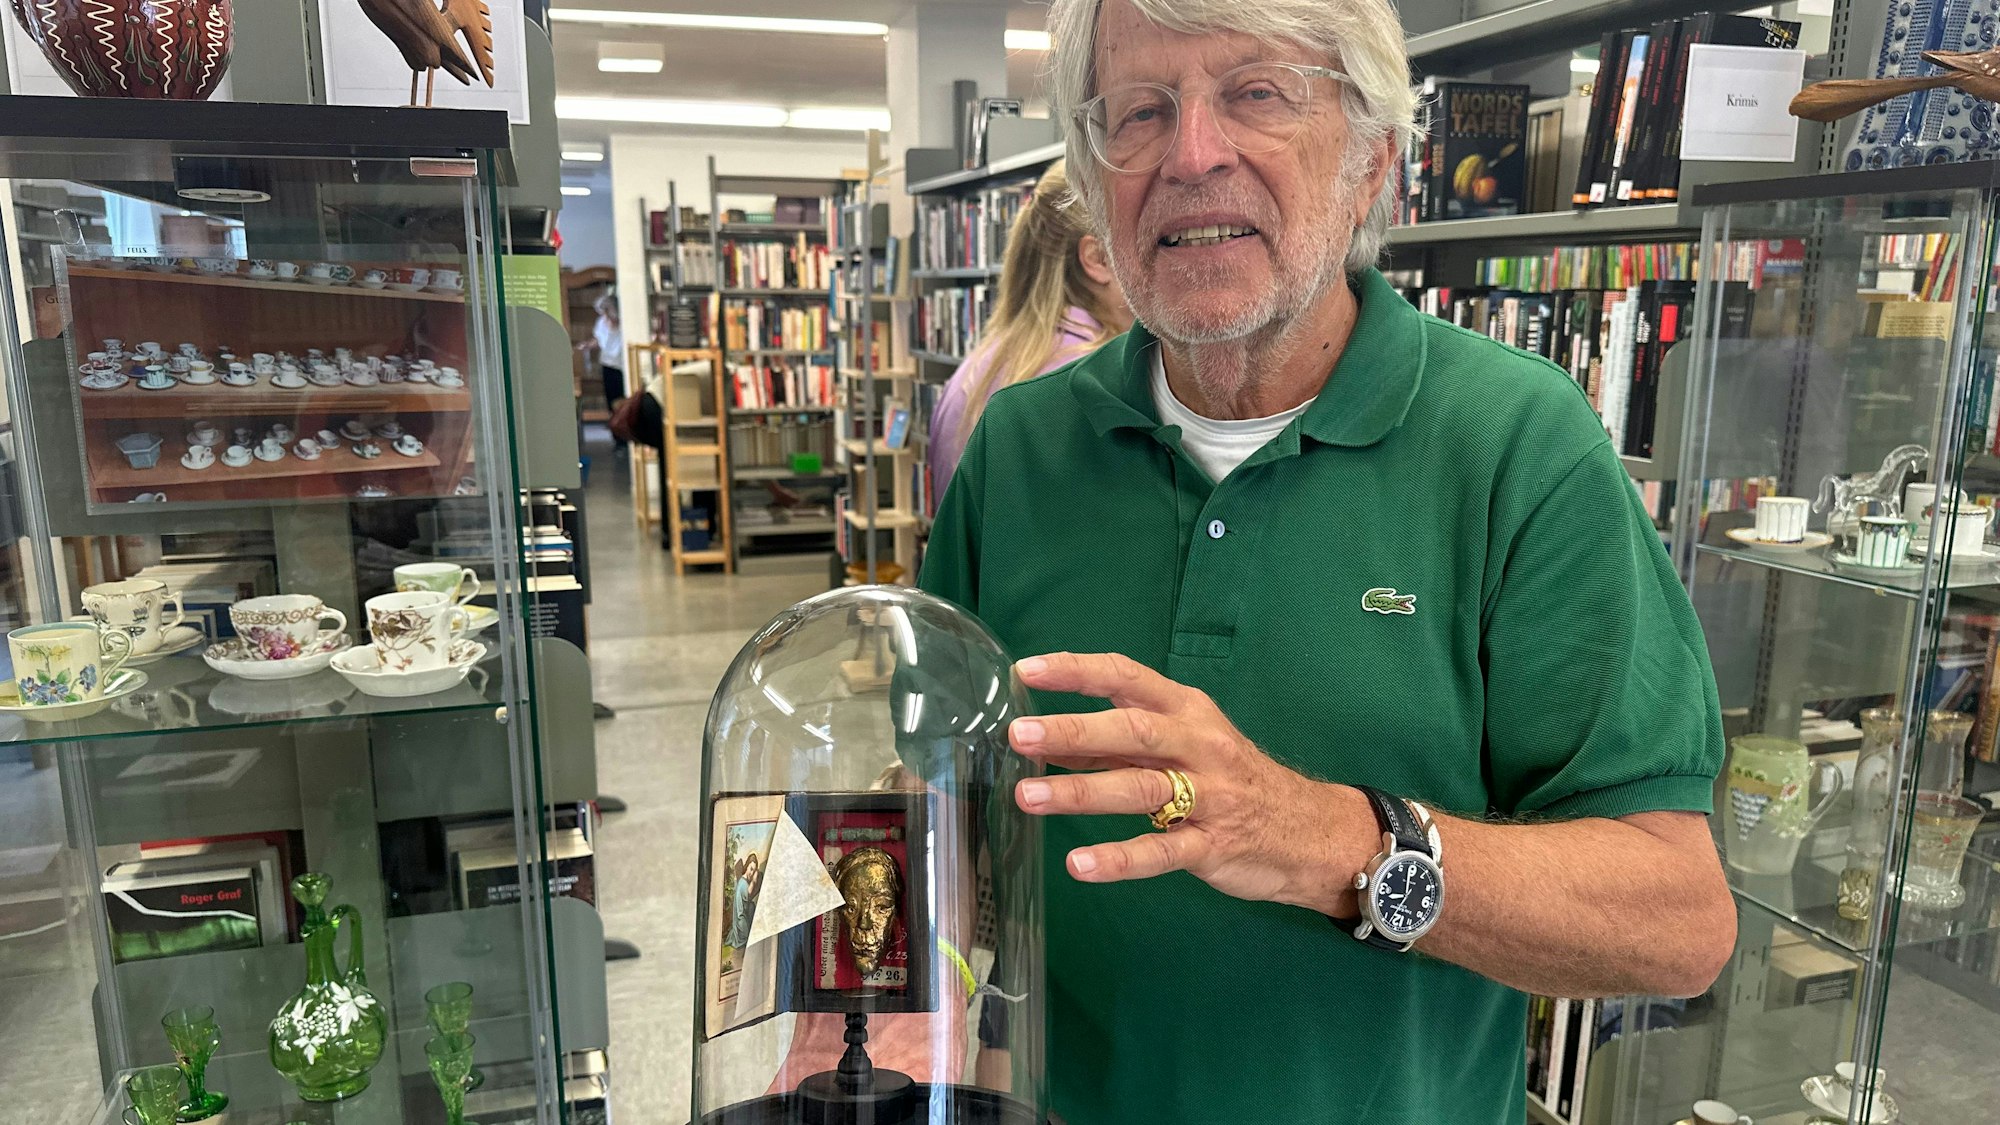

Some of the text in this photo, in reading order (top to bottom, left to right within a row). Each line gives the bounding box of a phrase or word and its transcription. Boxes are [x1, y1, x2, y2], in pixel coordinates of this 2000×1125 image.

[1451, 93, 1523, 114] MORDS
[1726, 93, 1759, 107] Krimis
[1451, 113, 1521, 133] TAFEL
[180, 888, 242, 905] Roger Graf
